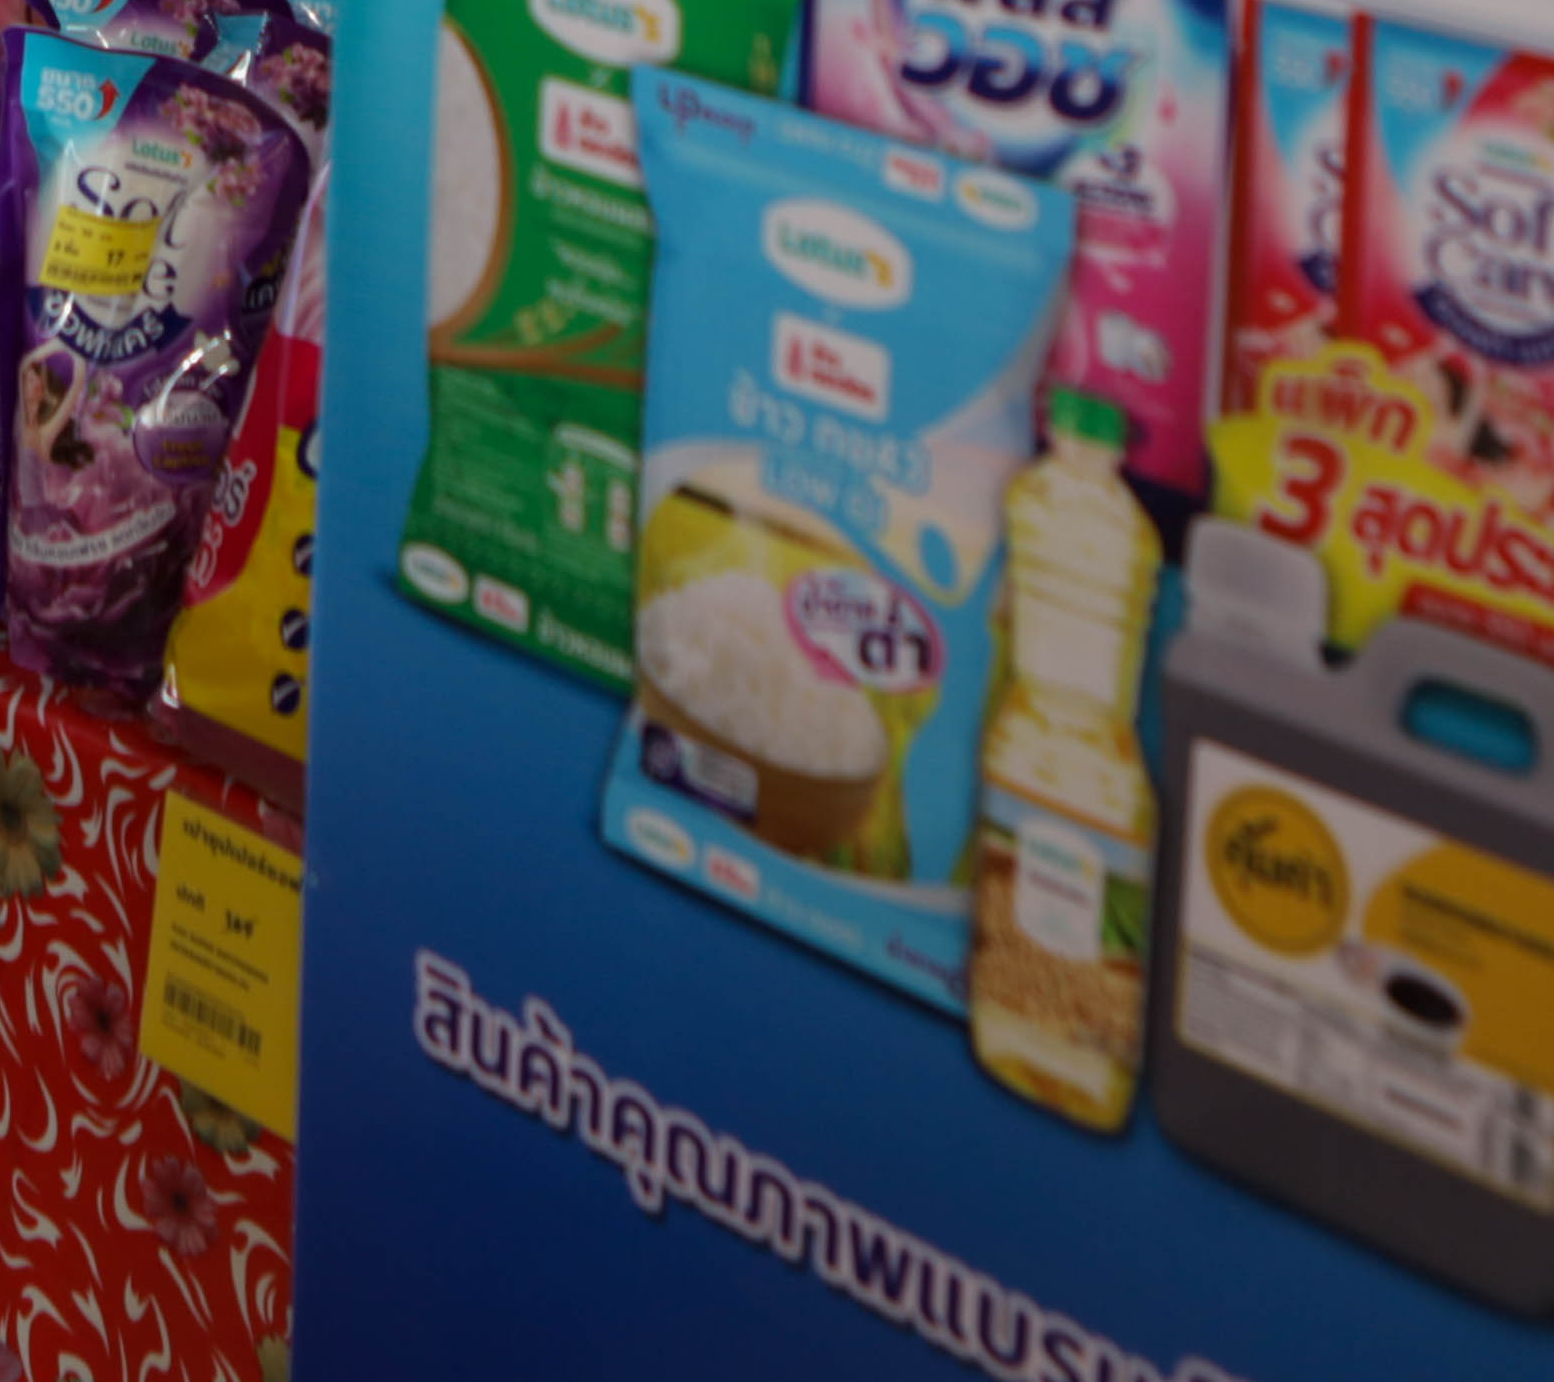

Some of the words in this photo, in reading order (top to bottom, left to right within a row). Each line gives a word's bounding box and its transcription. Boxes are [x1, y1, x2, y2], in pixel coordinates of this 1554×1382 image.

[36, 84, 95, 120] 550
[131, 138, 193, 170] Lotus's
[1257, 434, 1343, 550] 3
[416, 949, 1248, 1382] สินค้าคุณภาพแบร
